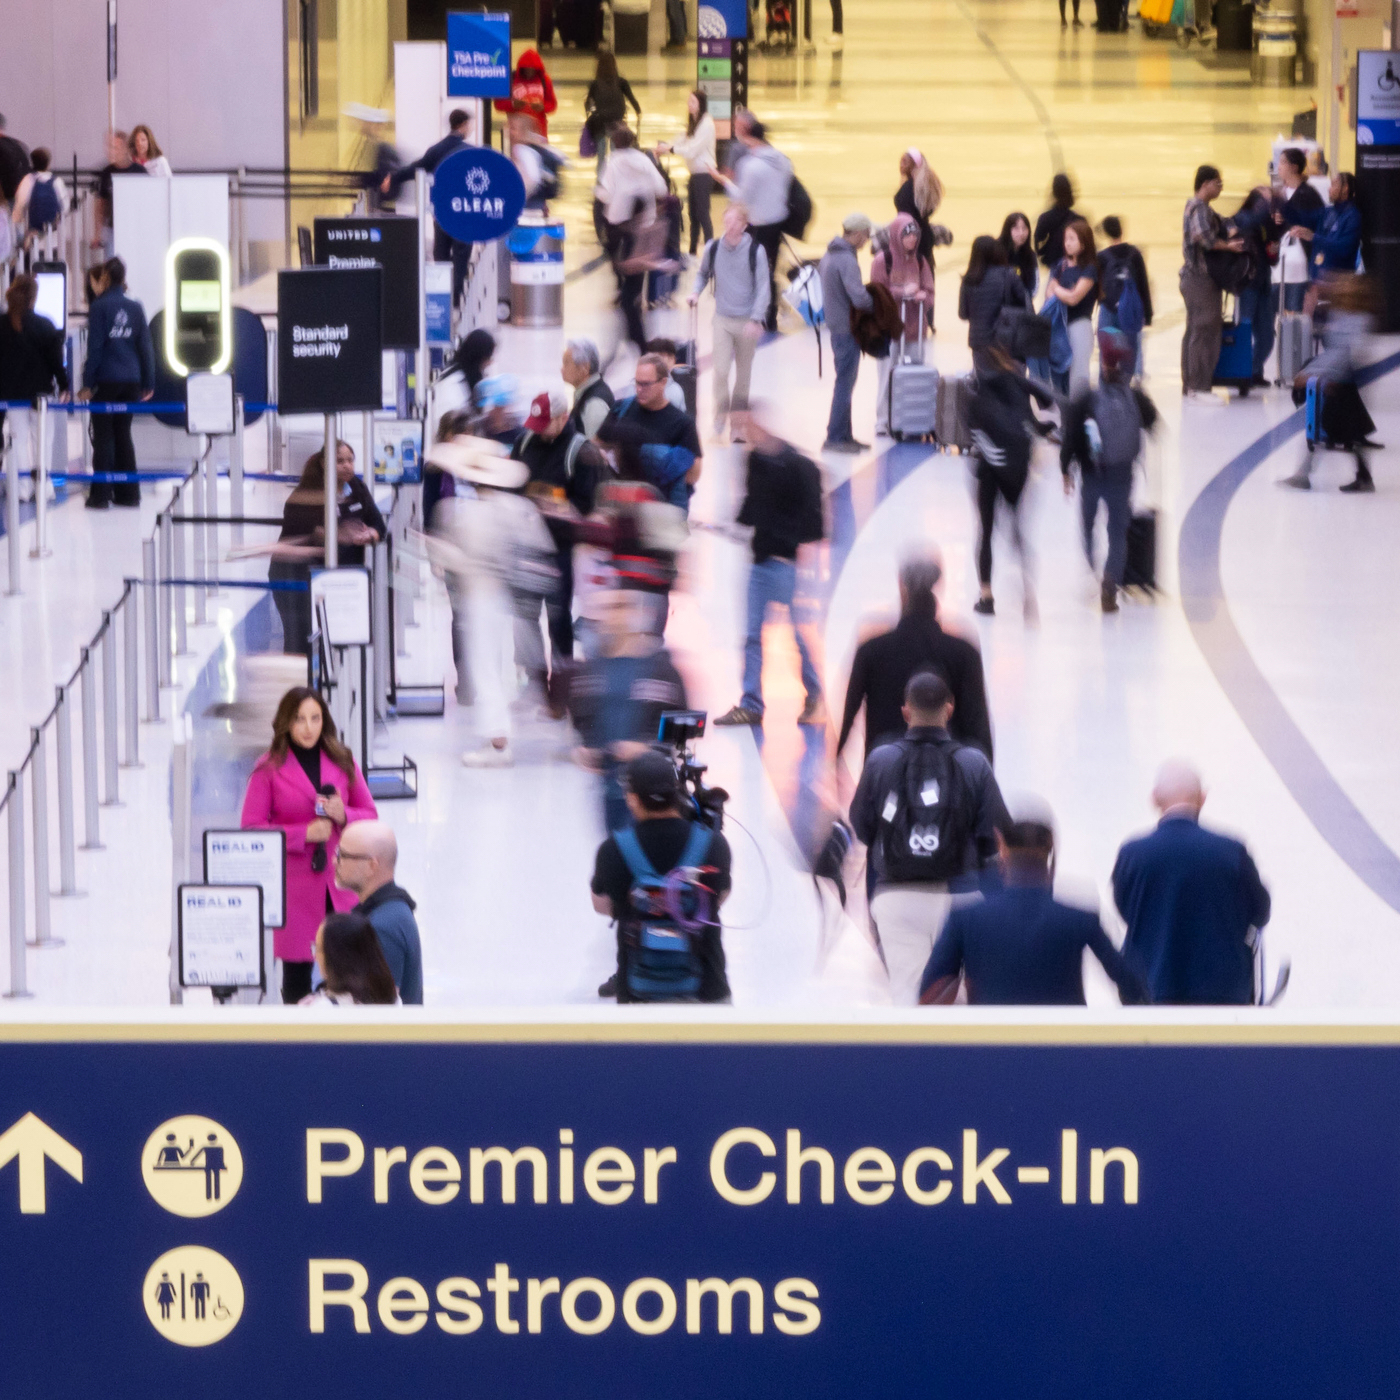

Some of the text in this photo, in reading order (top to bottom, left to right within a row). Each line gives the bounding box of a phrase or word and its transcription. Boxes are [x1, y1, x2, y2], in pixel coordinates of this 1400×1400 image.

[453, 50, 490, 66] TSA Pre
[451, 63, 507, 78] Checkpoint
[451, 196, 505, 213] CLEAR
[327, 229, 369, 241] UNITED
[328, 254, 377, 269] Premier
[292, 323, 349, 342] Standard
[292, 341, 342, 359] security
[212, 840, 265, 854] REAL ID
[187, 895, 243, 908] REAL ID
[306, 1127, 1140, 1206] Premier Check-In
[308, 1258, 822, 1336] Restrooms
